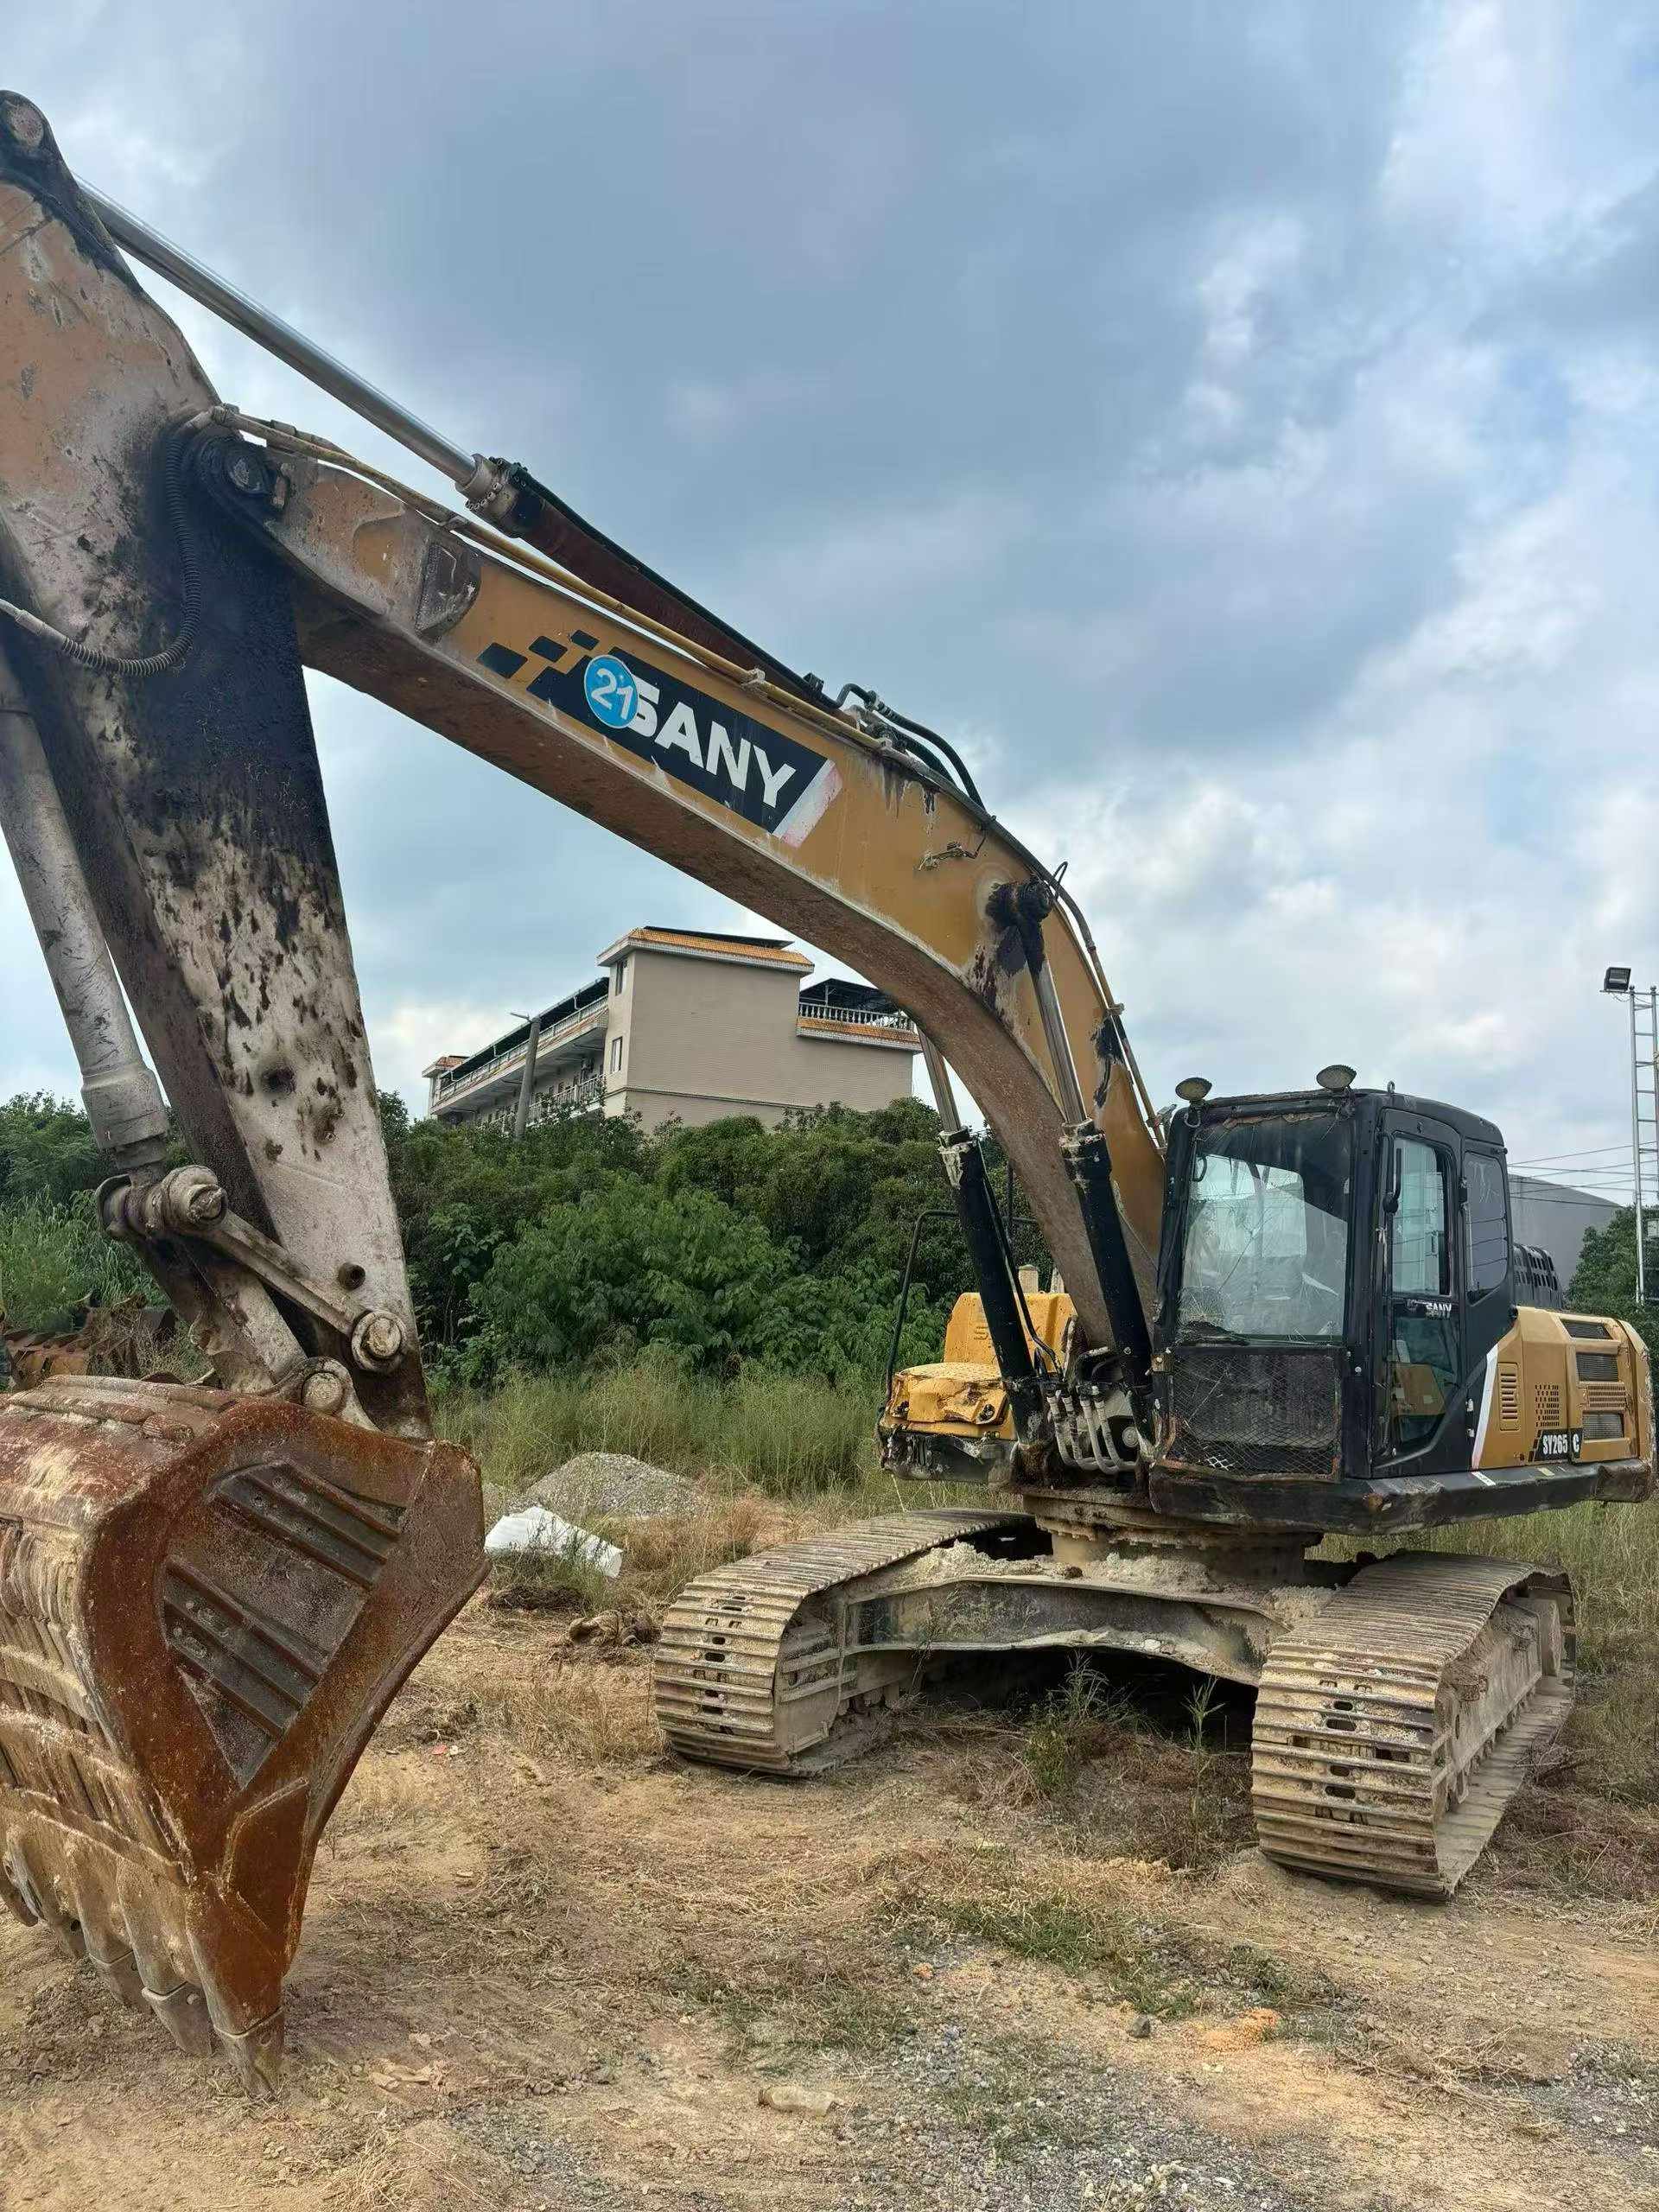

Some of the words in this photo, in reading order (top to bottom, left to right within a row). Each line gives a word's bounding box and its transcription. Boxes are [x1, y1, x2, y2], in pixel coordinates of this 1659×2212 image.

[591, 668, 633, 720] 21
[629, 674, 796, 808] SANY
[1542, 1433, 1568, 1455] SY265
